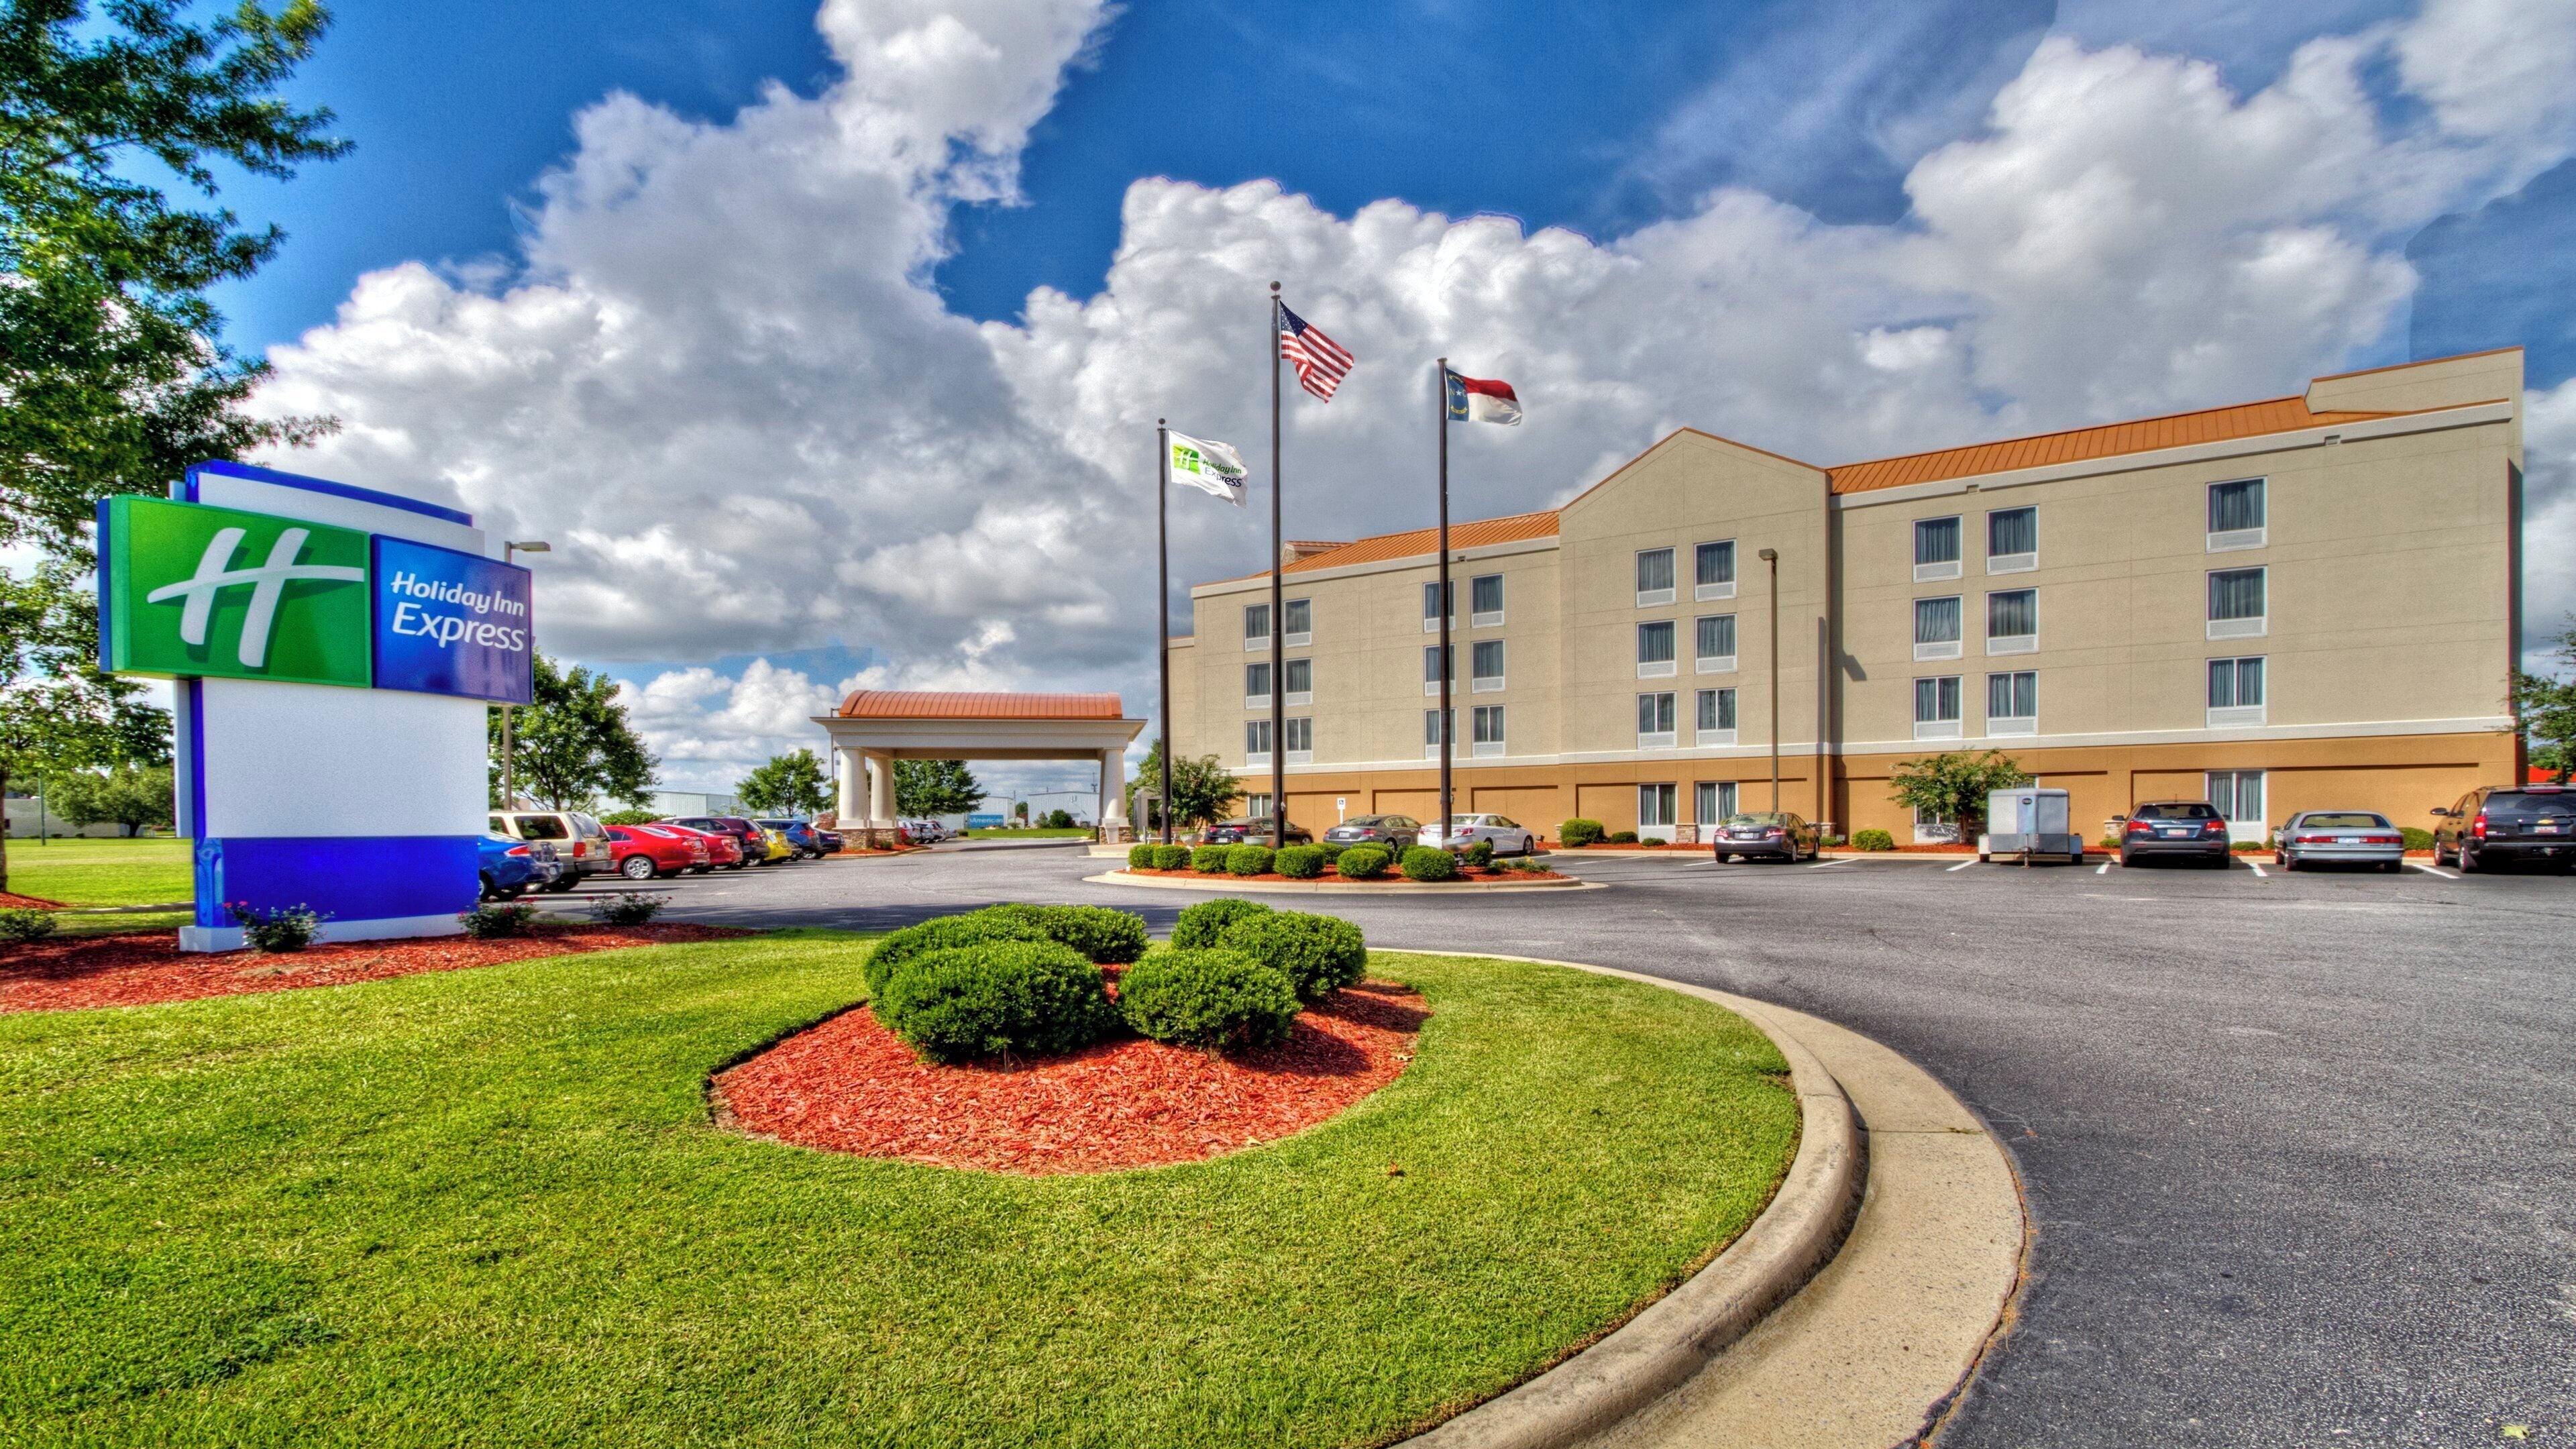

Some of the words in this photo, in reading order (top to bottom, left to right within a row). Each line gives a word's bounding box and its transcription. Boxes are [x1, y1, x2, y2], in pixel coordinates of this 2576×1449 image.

[1203, 459, 1230, 474] Holiday
[1230, 465, 1242, 474] Inn
[1205, 468, 1242, 487] Express
[391, 571, 490, 614] Holiday
[494, 590, 525, 616] Inn
[392, 602, 525, 652] Express
